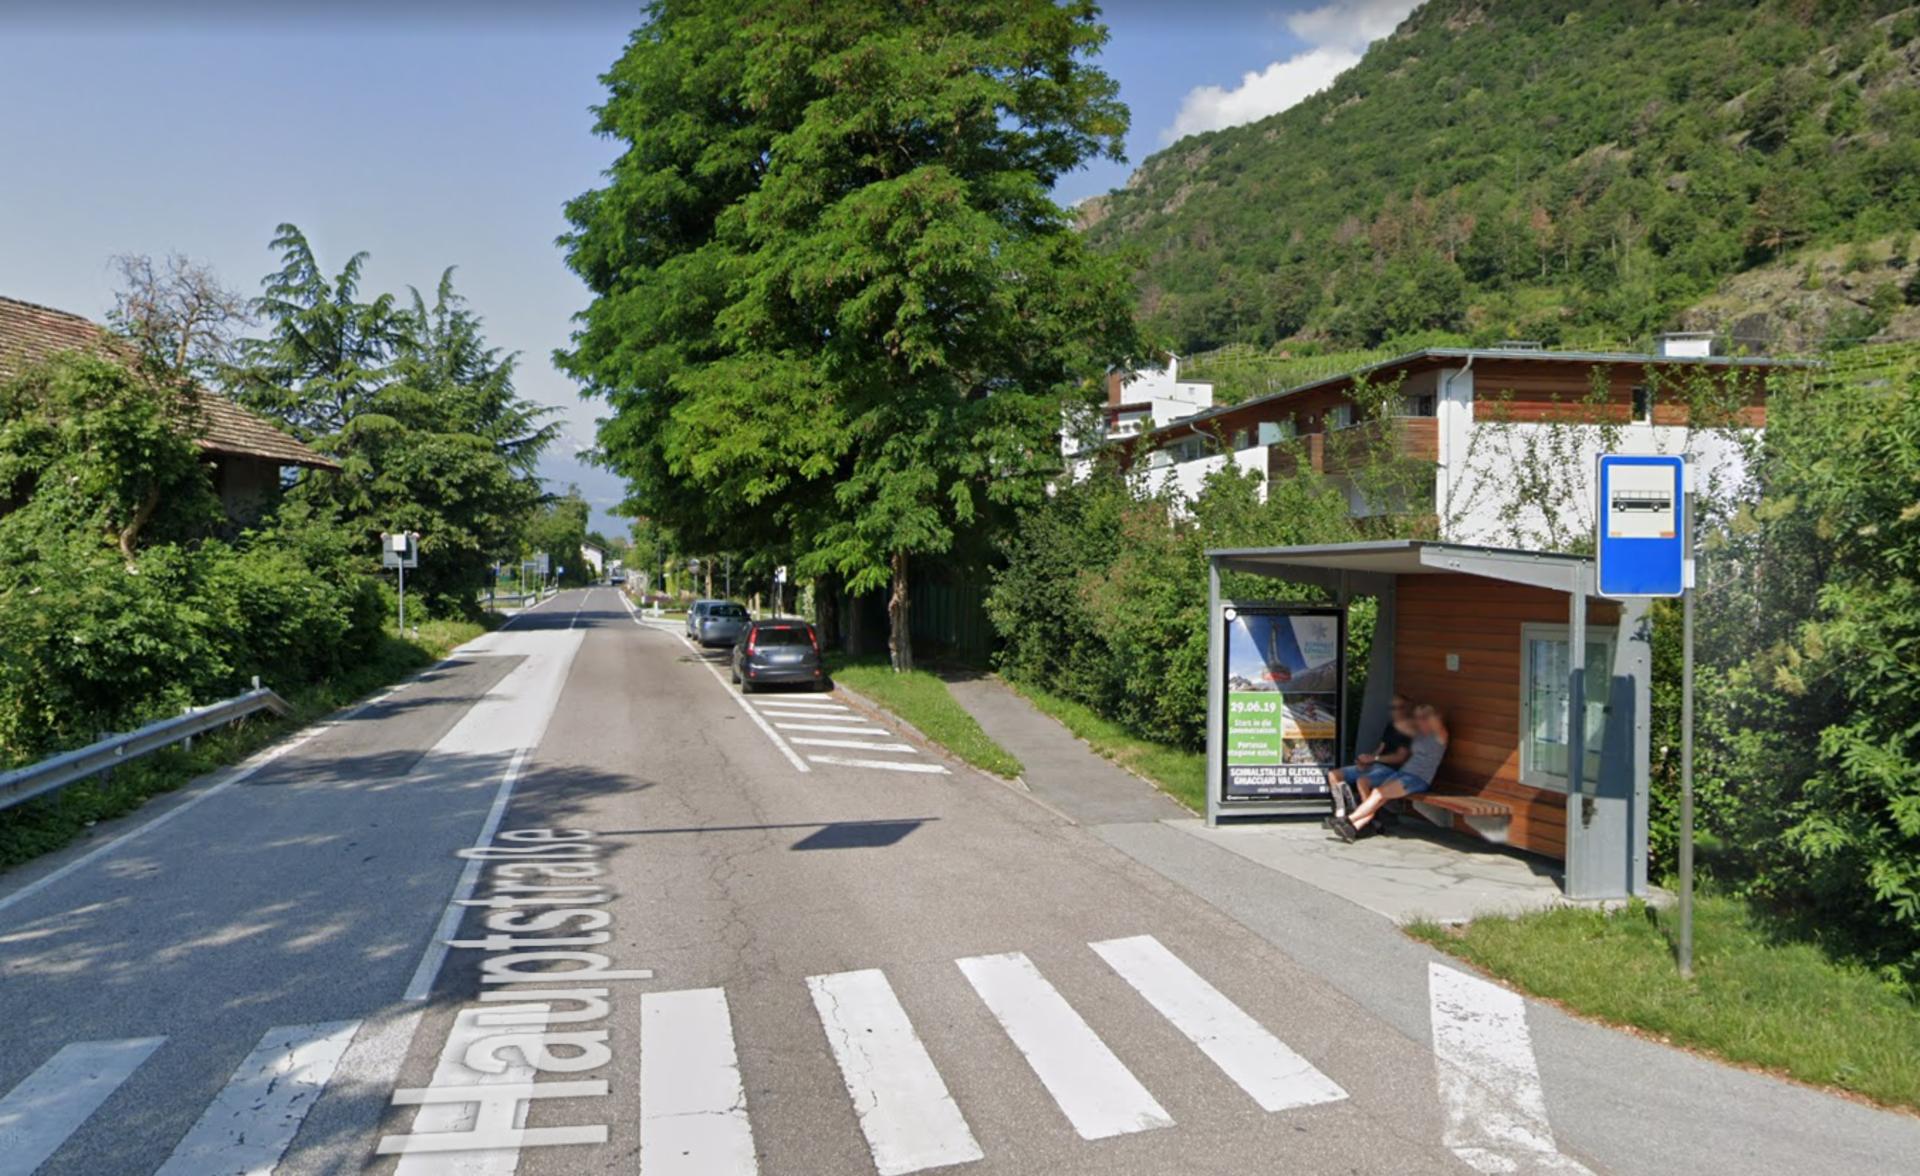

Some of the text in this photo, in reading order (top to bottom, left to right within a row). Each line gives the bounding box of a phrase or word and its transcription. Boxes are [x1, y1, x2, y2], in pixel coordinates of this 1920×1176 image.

[1231, 701, 1276, 713] 29.06.19
[1233, 776, 1326, 785] GHIACCIAIO VAL SENALES
